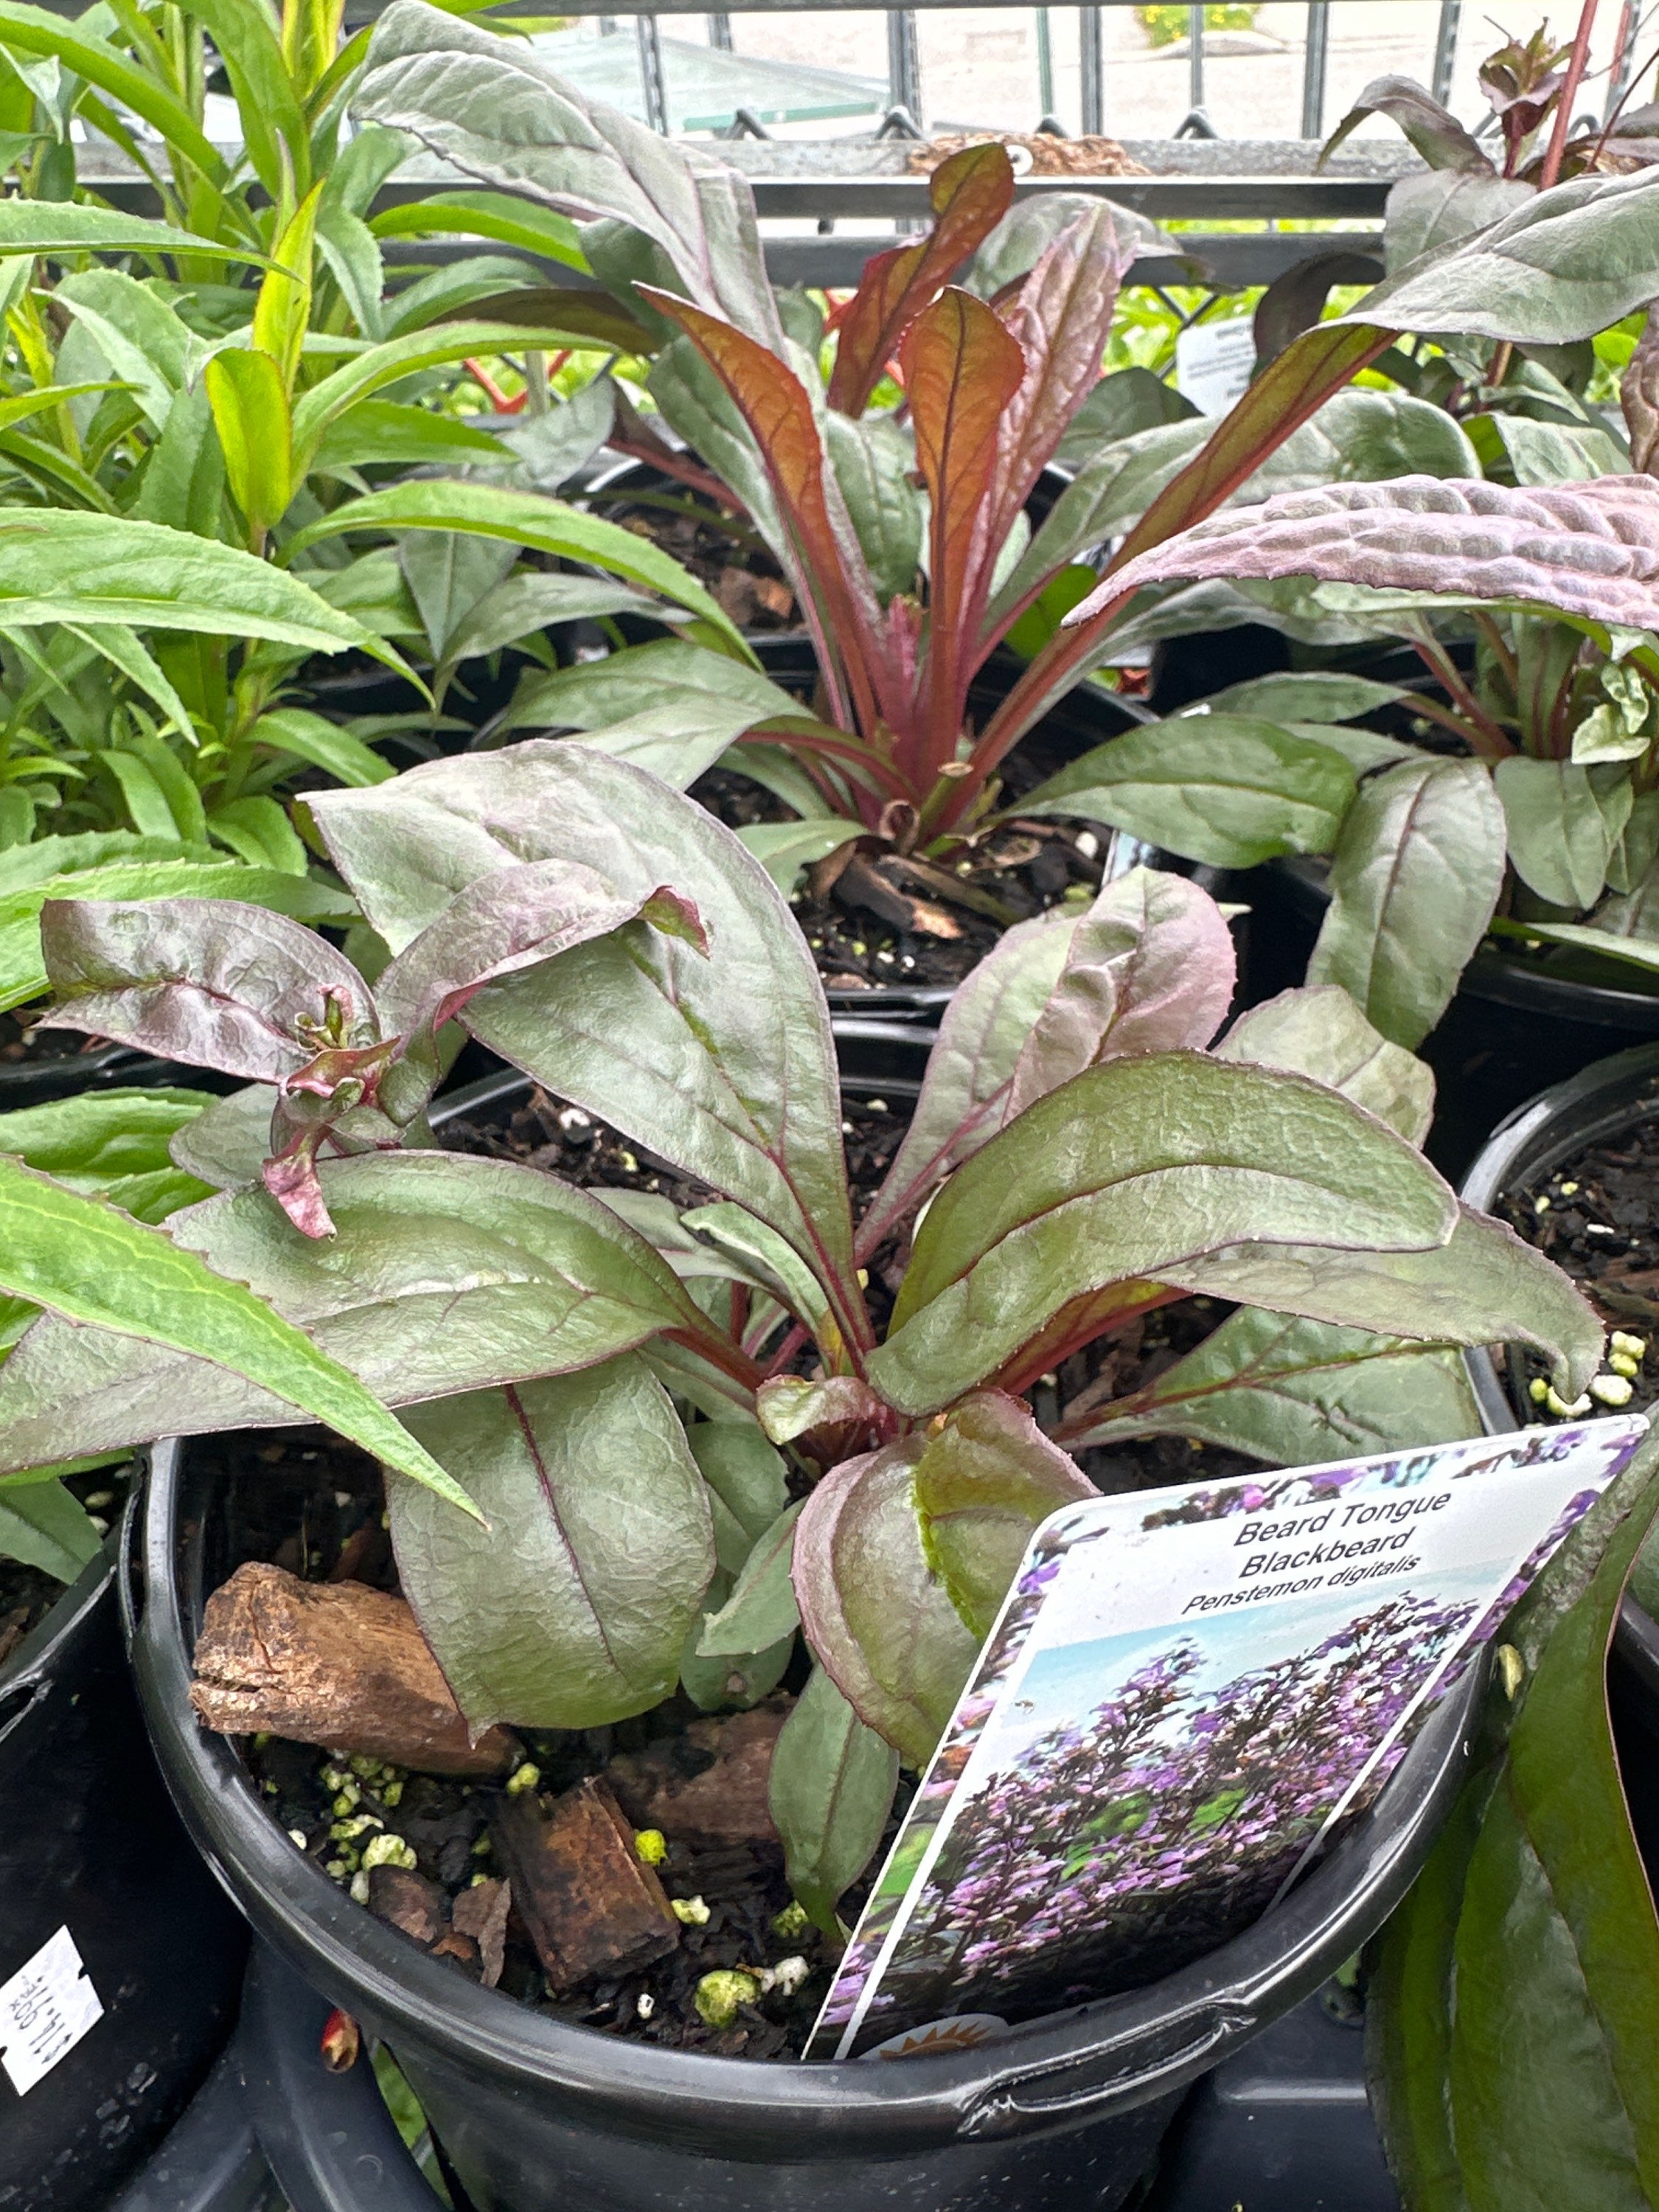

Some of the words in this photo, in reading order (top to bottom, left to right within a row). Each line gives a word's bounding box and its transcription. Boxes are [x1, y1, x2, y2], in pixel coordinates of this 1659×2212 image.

[1234, 1509, 1335, 1547] Beard
[1340, 1492, 1452, 1527] Tongue
[1239, 1526, 1416, 1578] Blackbeard
[1181, 1576, 1321, 1615] Penstemon
[1327, 1554, 1422, 1587] digitalis
